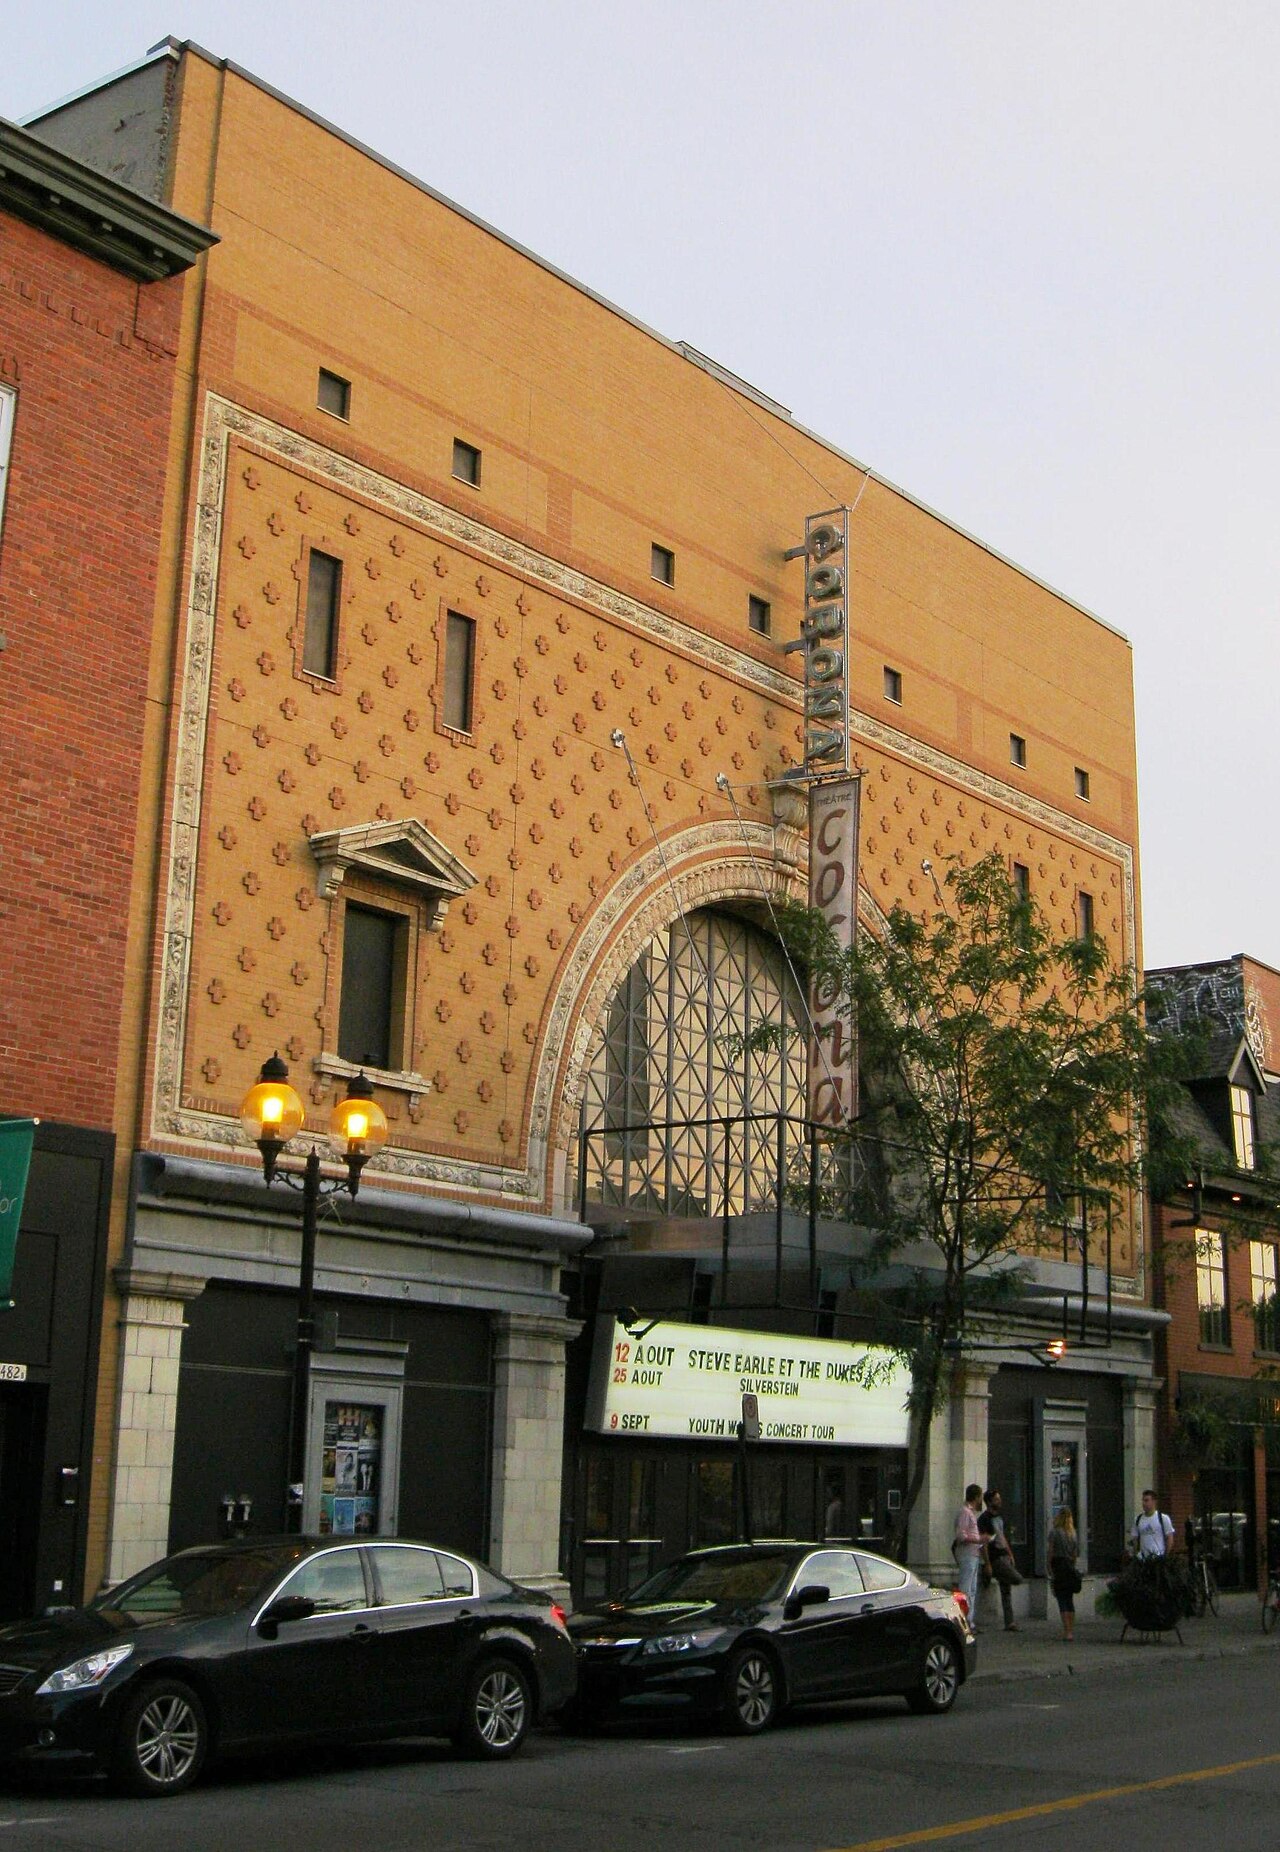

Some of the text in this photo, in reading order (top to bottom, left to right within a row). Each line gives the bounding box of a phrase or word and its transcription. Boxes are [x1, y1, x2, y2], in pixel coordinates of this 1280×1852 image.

[615, 1342, 630, 1363] 12
[688, 1350, 731, 1372] STEVE
[734, 1354, 775, 1375] EARLE
[779, 1358, 795, 1377] ET
[799, 1360, 821, 1379] THE
[826, 1362, 864, 1383] DUKES
[613, 1367, 799, 1396] 25 AOUT SILVERSTEIN
[610, 1413, 619, 1429] 9
[621, 1414, 650, 1430] SEPT
[688, 1418, 725, 1435] YOUTH
[766, 1422, 808, 1439] CONCERT
[811, 1425, 835, 1440] TOUR
